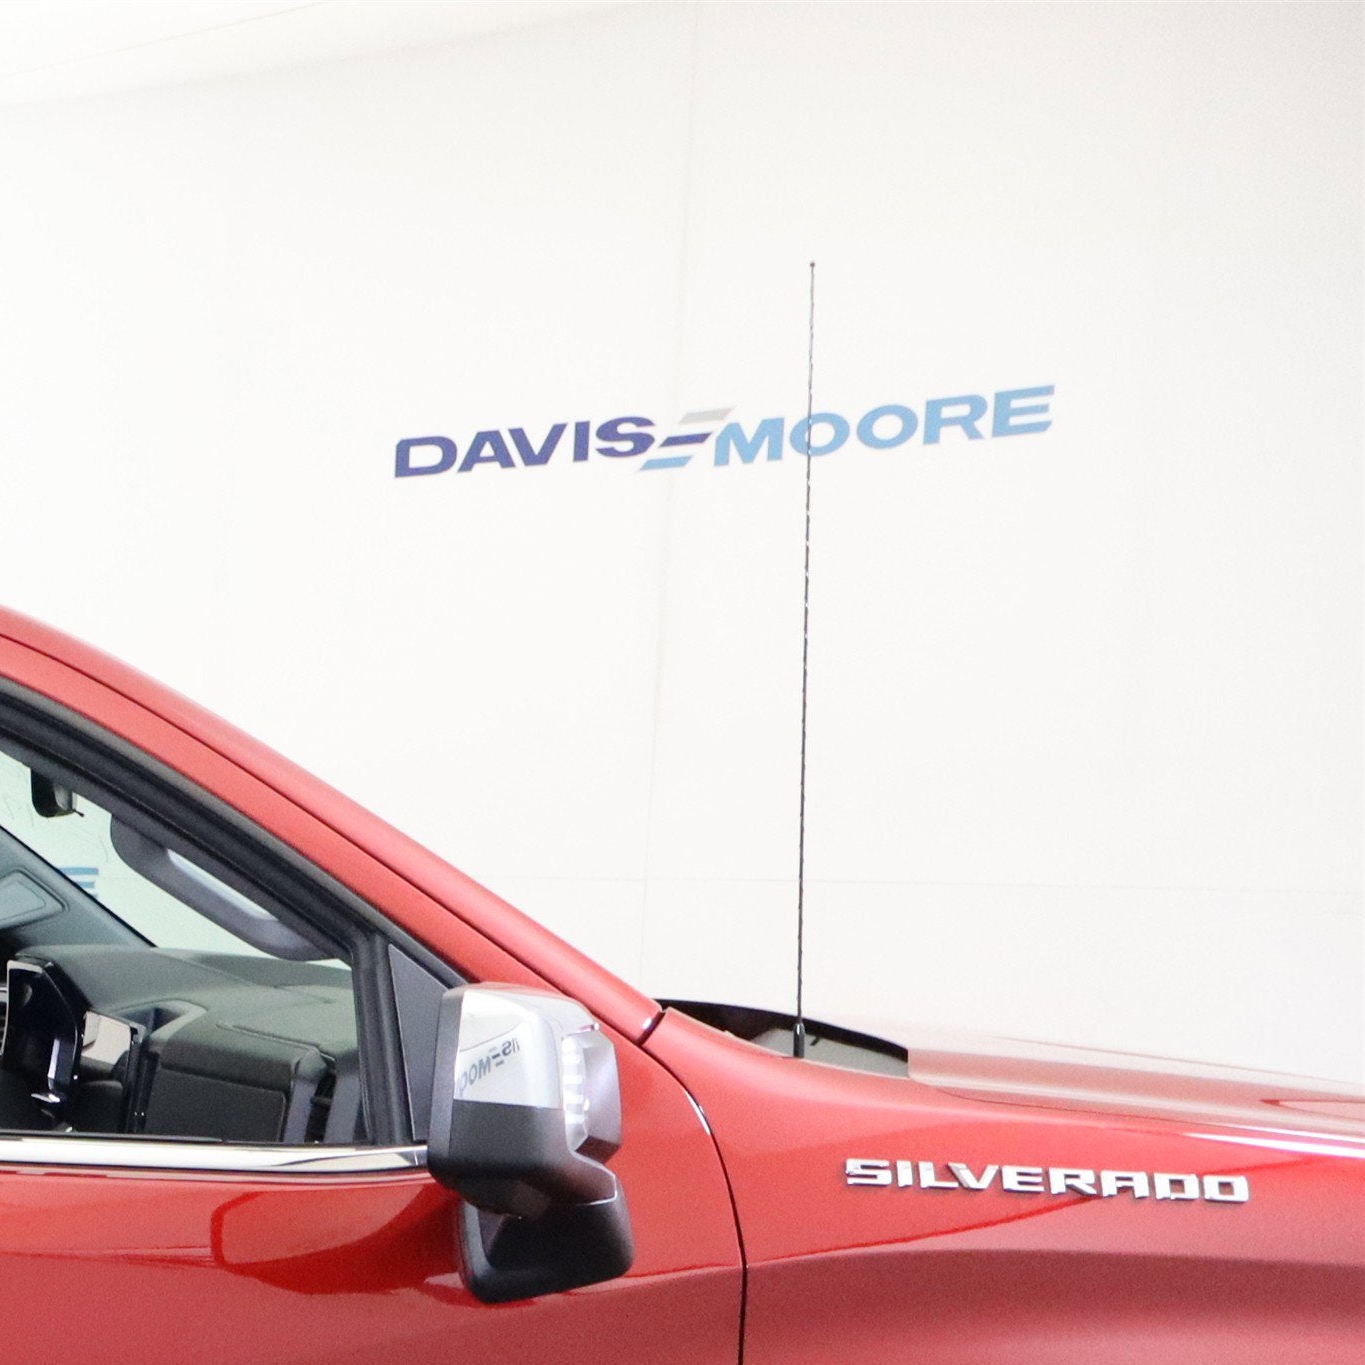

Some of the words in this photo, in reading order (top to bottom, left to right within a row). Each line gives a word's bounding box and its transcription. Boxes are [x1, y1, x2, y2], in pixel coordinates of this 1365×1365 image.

[395, 416, 656, 478] DAVIS
[713, 385, 1055, 467] MOORE
[845, 1158, 1249, 1202] SILVERADO
